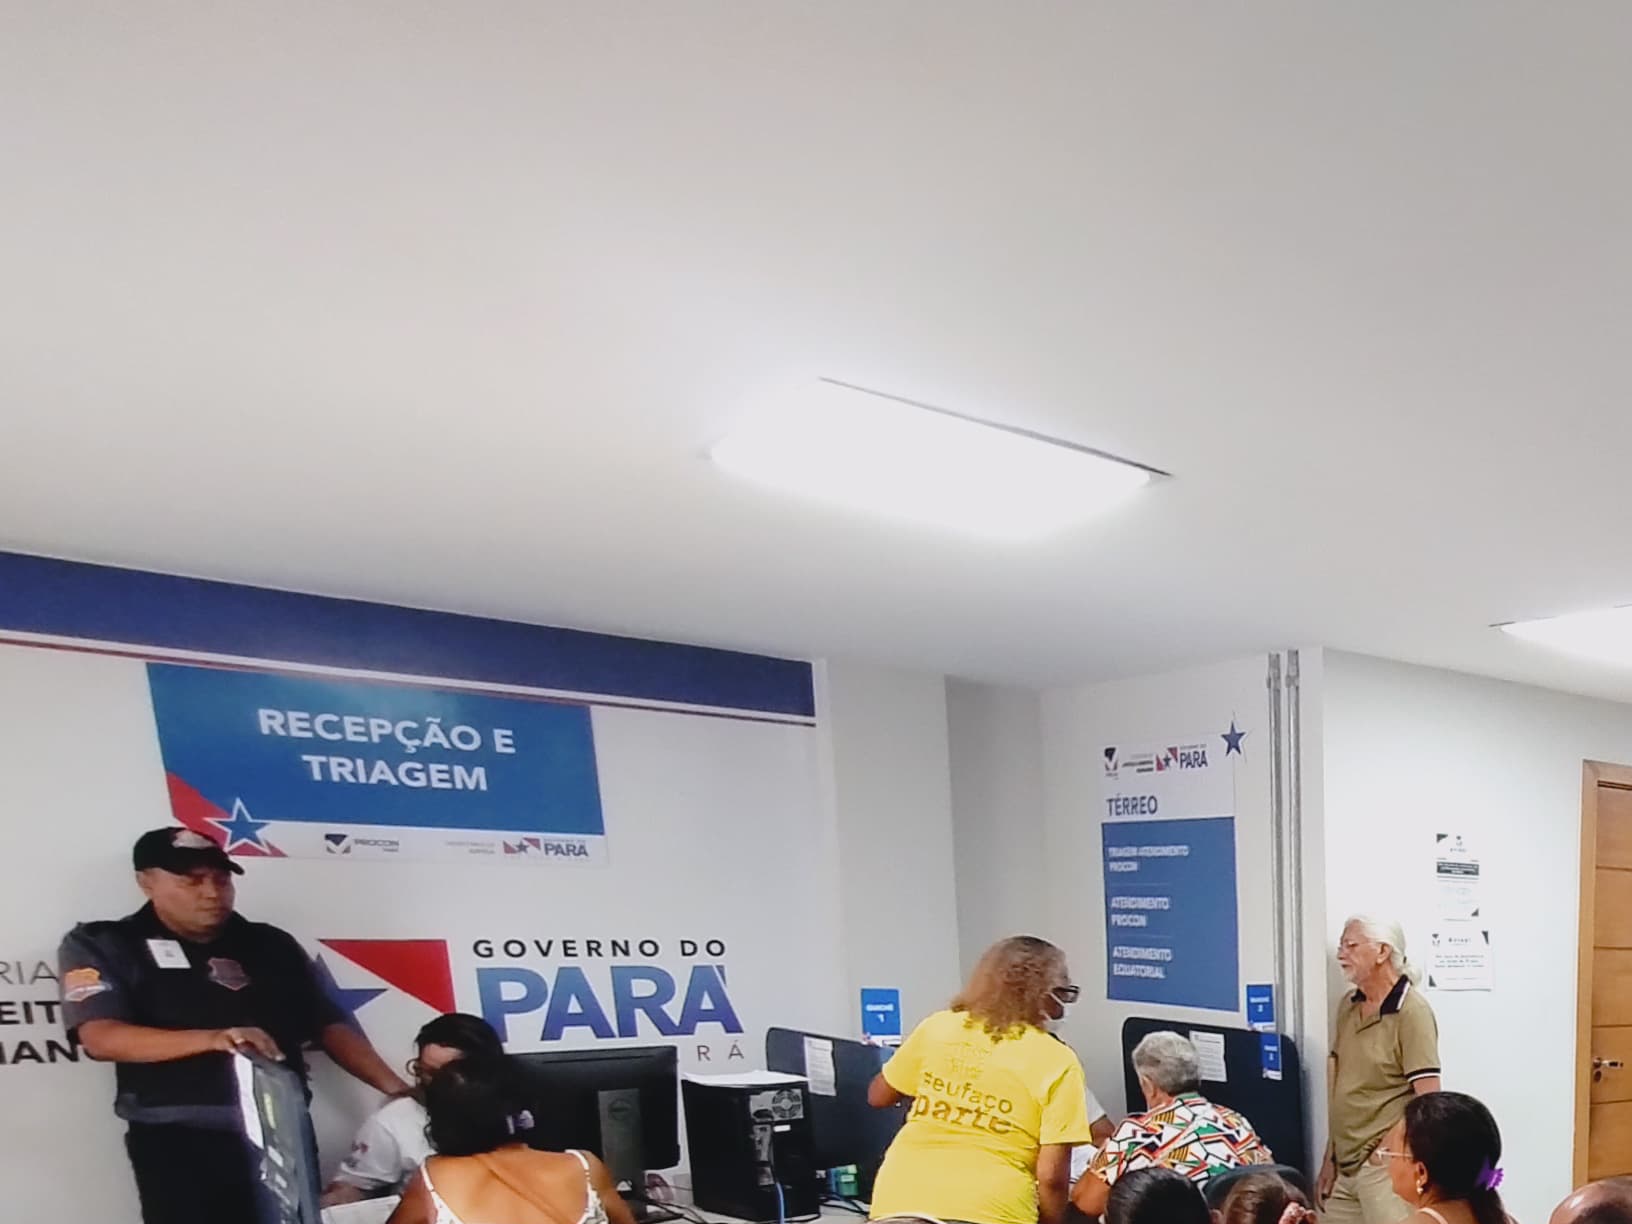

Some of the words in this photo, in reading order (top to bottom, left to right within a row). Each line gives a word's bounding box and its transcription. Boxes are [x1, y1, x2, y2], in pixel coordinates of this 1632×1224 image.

[257, 708, 482, 754] RECEPÇÃO
[493, 728, 516, 754] E
[301, 754, 488, 791] TRIAGEM
[1106, 792, 1159, 817] TÉRREO
[1110, 896, 1170, 910] ATENDIMENTO
[472, 939, 660, 958] GOVERNO
[680, 939, 726, 957] DO
[1112, 945, 1172, 962] ATENDIMENTO
